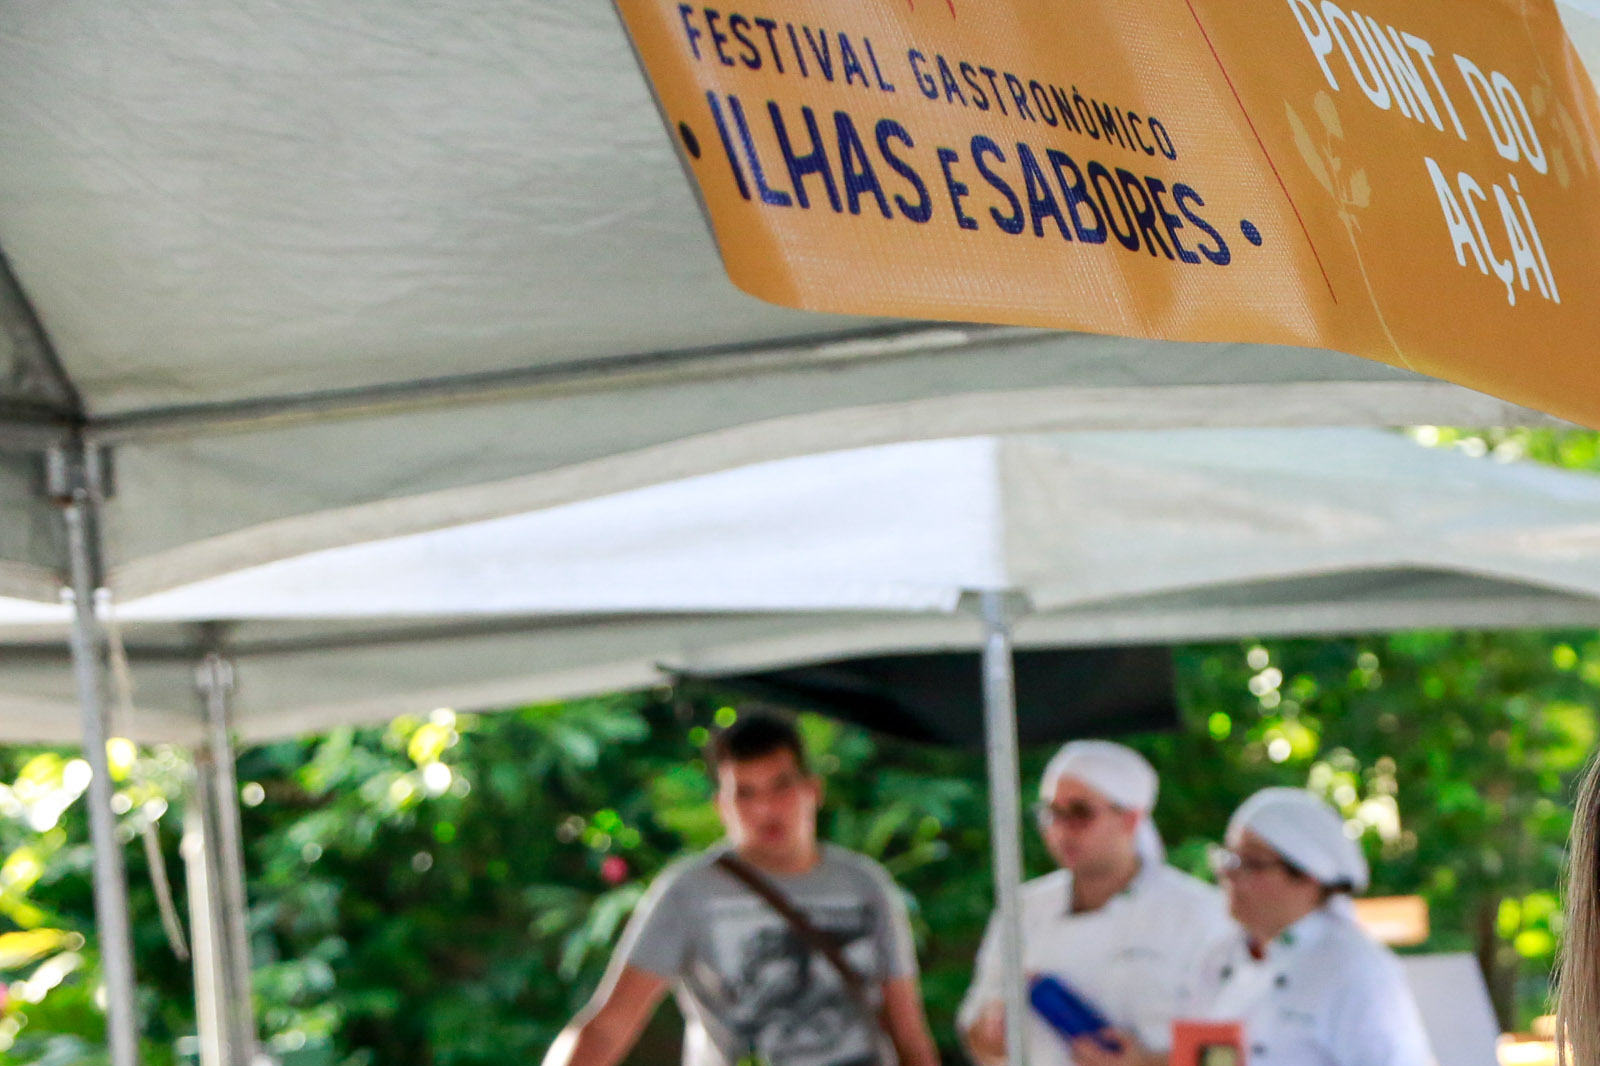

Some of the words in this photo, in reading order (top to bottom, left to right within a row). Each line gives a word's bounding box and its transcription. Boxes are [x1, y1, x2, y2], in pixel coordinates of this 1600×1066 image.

[678, 2, 896, 94] FESTIVAL
[1287, 0, 1467, 141] POINT
[1453, 53, 1548, 174] DO
[706, 90, 932, 224] ILHAS
[937, 147, 978, 229] E
[968, 134, 1232, 266] SABORES
